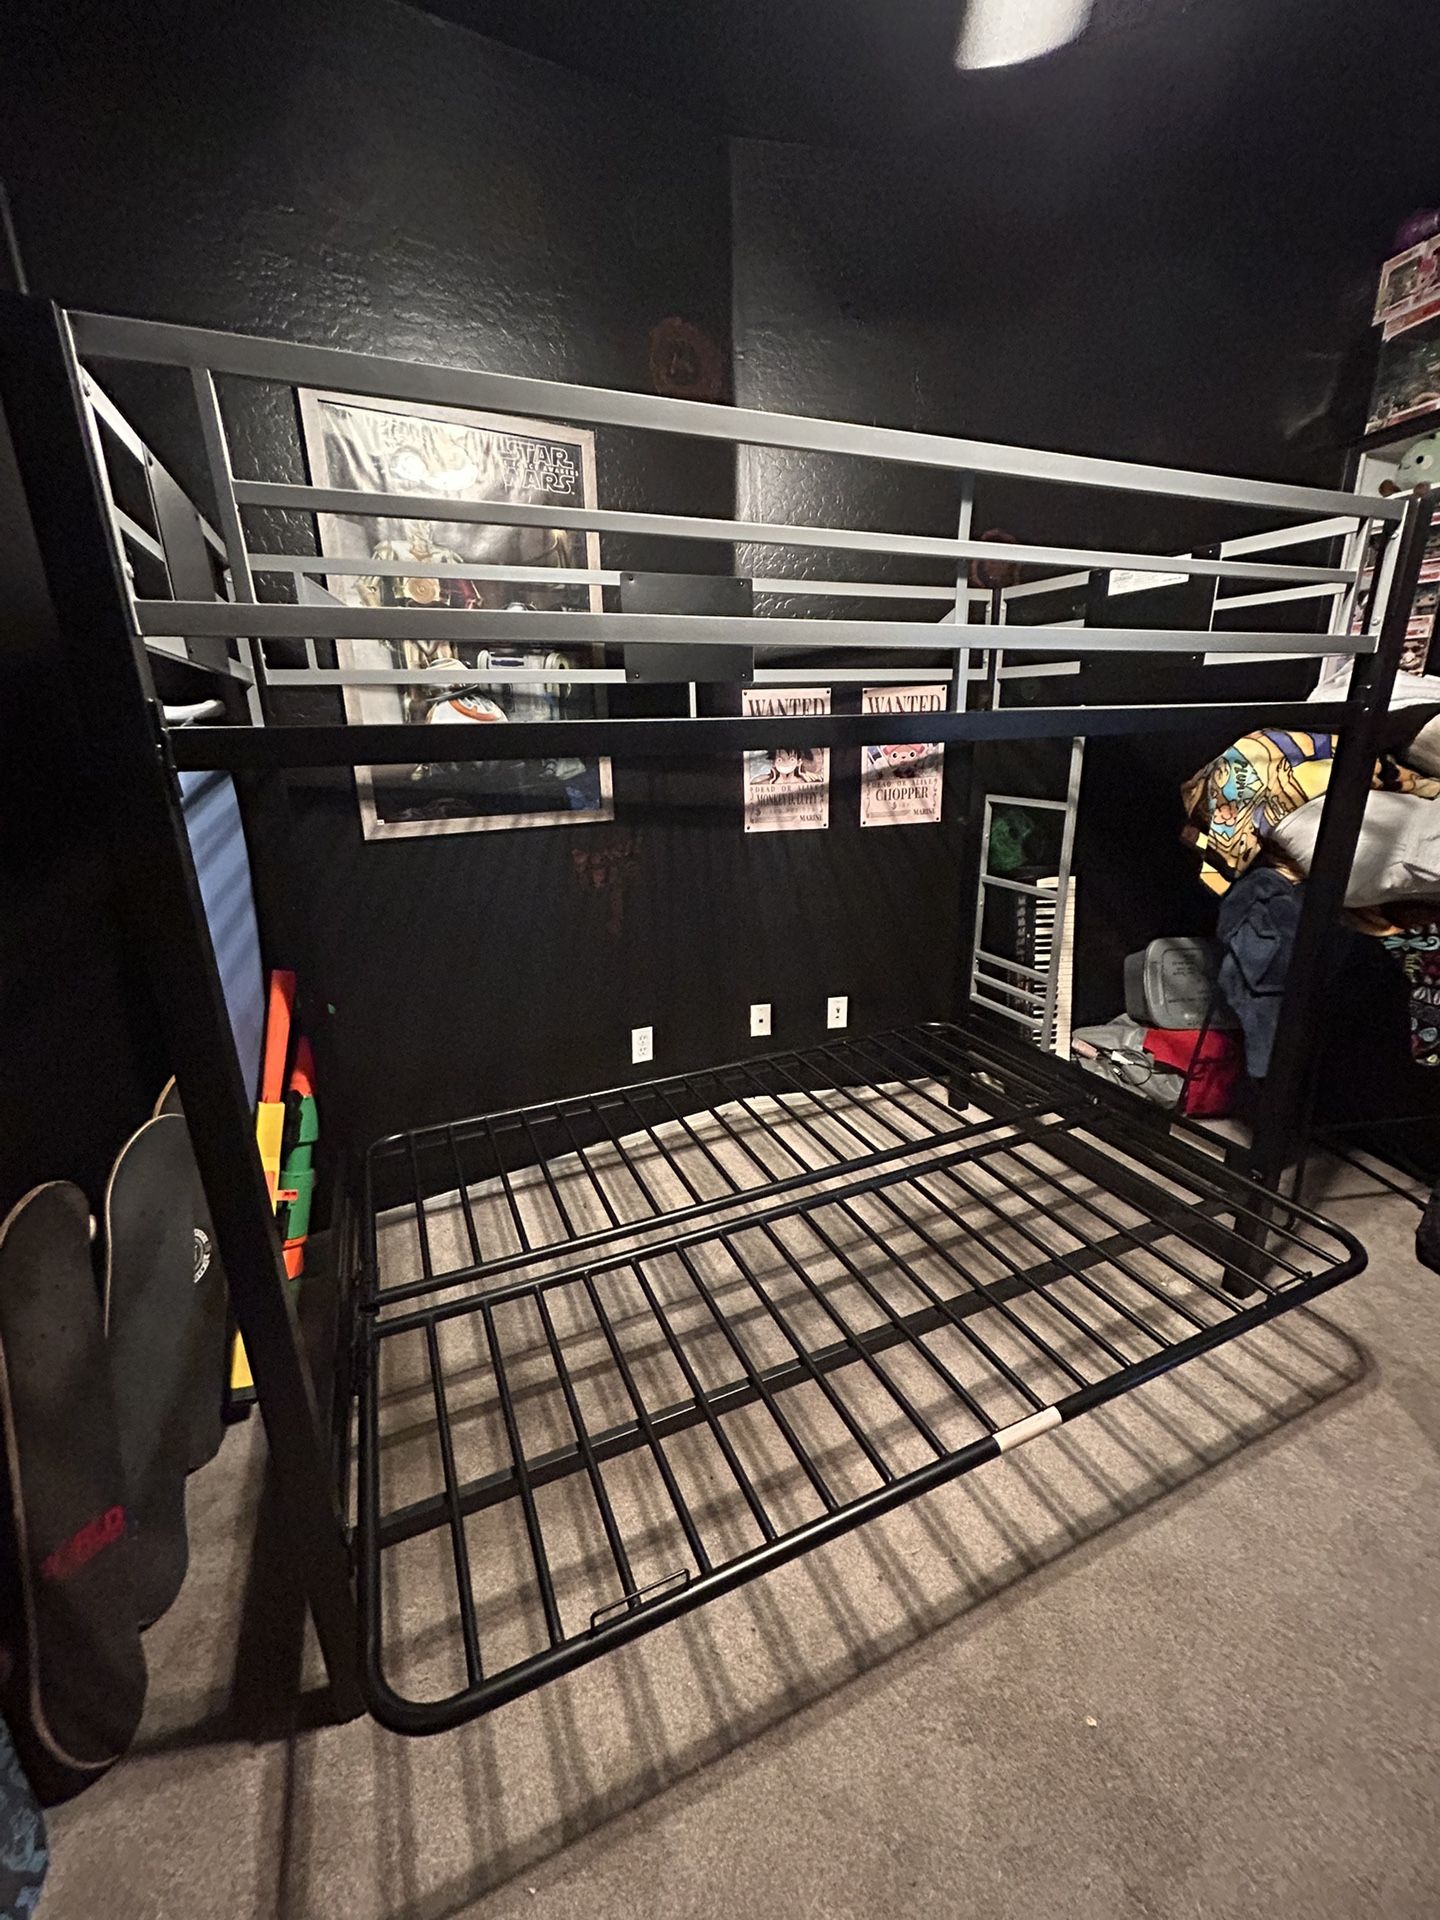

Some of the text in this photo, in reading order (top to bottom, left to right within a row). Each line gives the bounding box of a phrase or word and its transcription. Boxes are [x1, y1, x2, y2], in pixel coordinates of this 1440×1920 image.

[500, 438, 574, 469] STAR
[502, 467, 575, 495] WARS
[748, 698, 825, 716] WANTED
[867, 695, 941, 714] WANTED
[875, 786, 929, 801] CHOPPER
[800, 814, 822, 822] MARINE
[913, 808, 935, 816] MARINE
